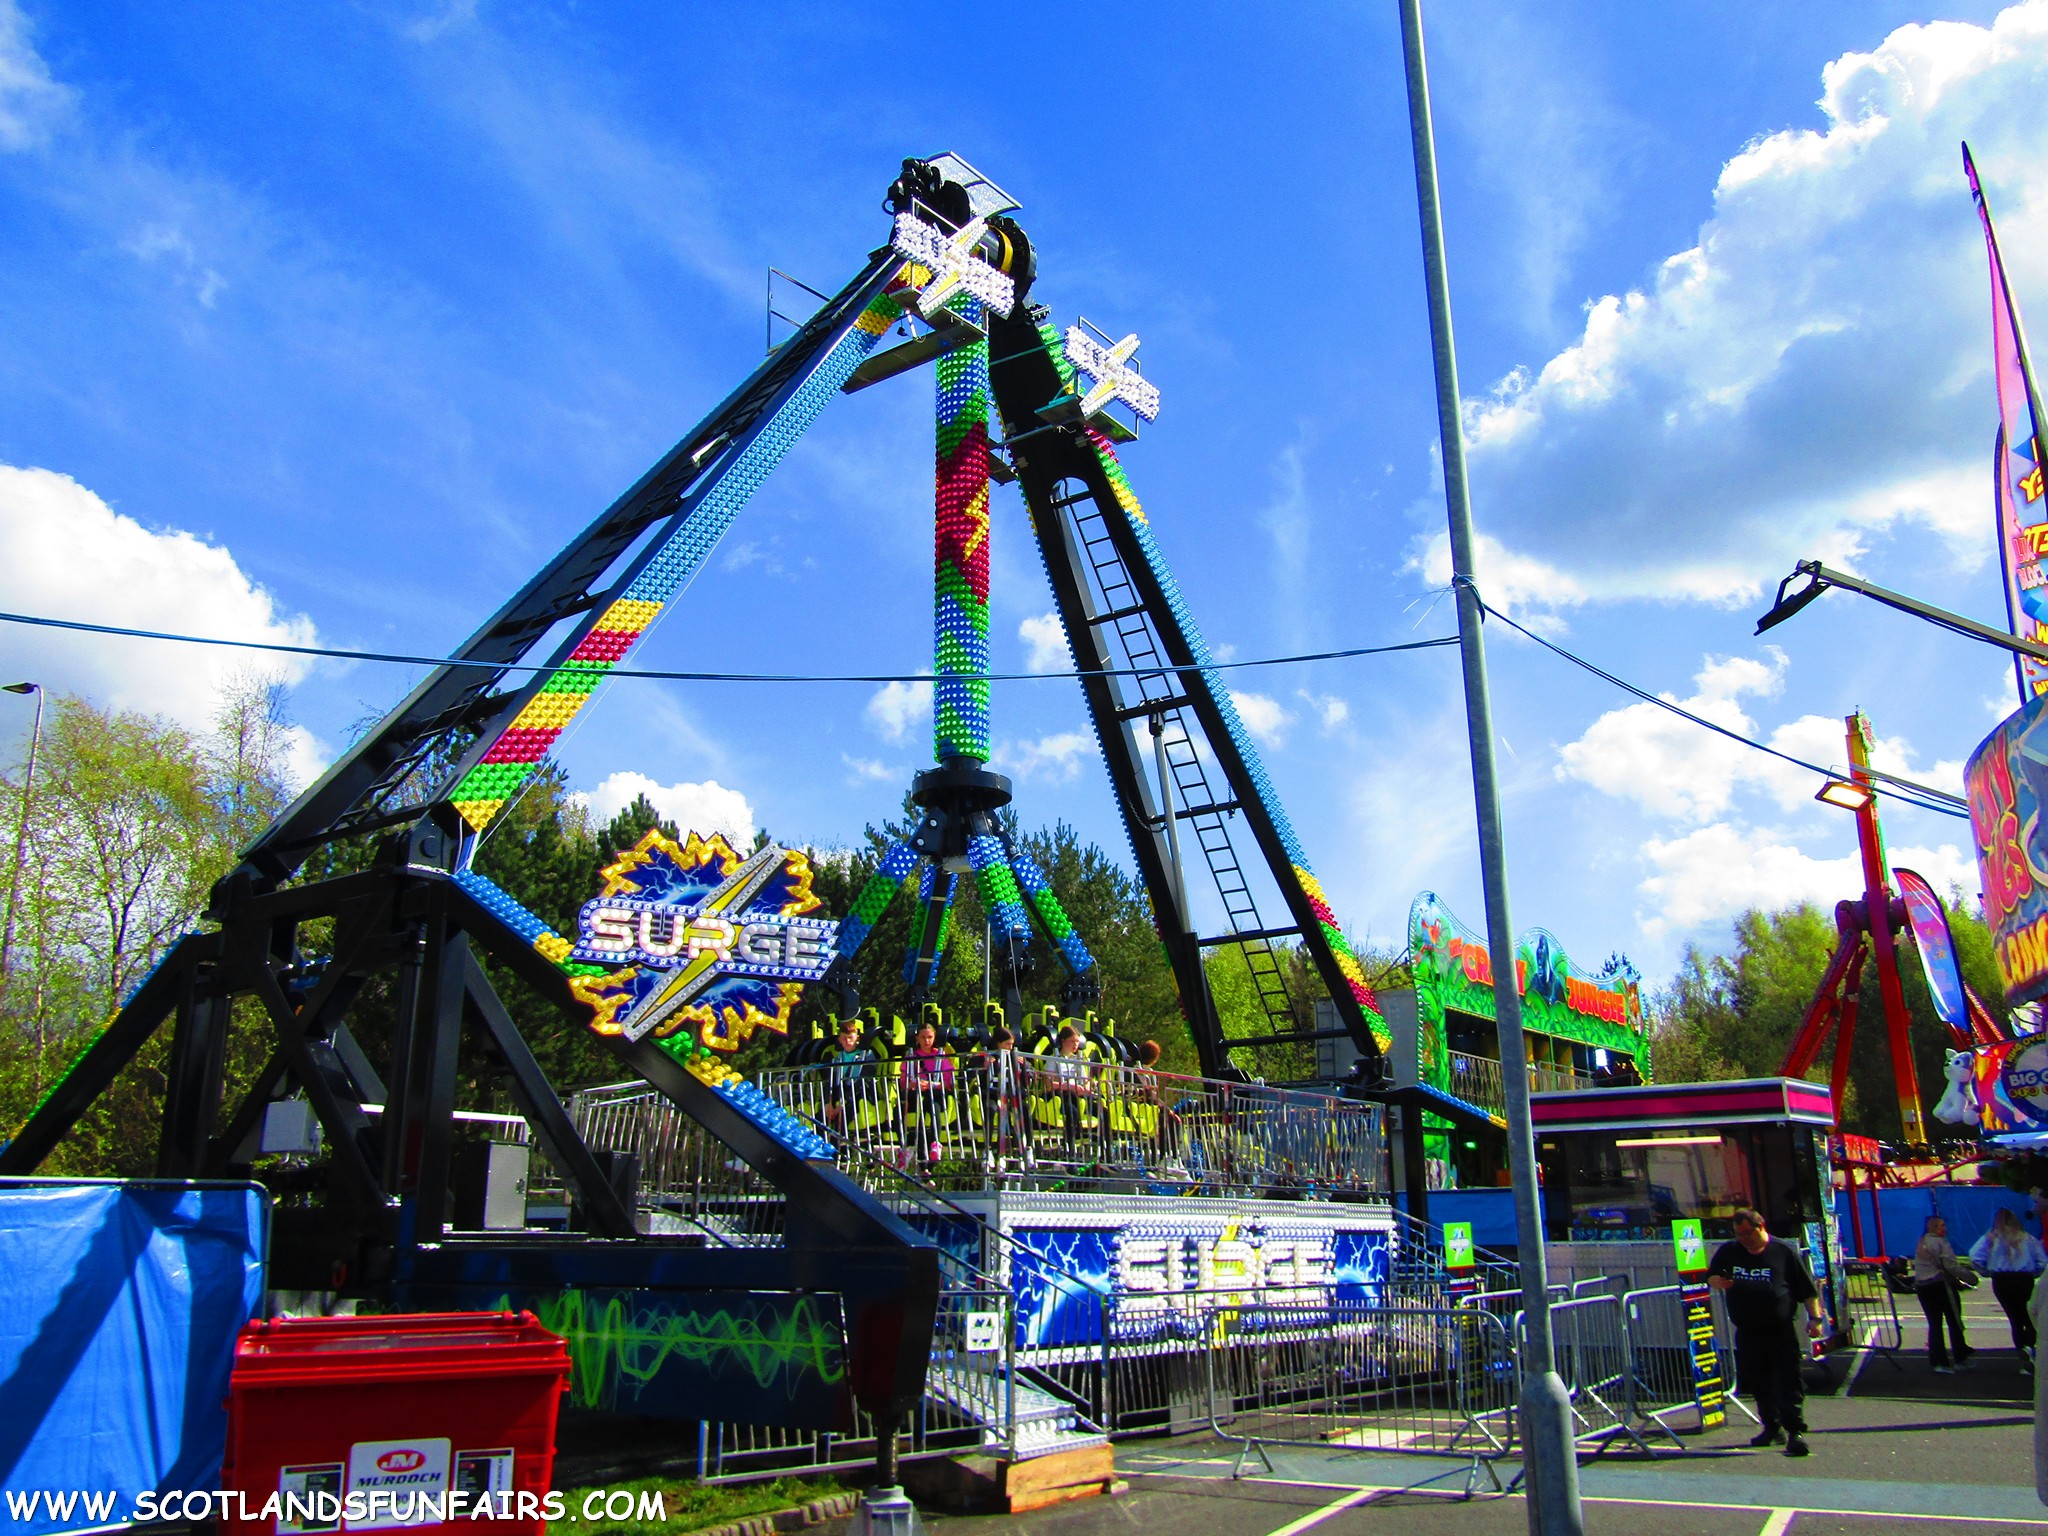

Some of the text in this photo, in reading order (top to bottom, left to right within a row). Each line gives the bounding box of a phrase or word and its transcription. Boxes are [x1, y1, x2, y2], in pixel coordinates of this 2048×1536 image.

[588, 907, 824, 969] SURGE
[1566, 976, 1627, 1026] JUNGLE
[2008, 1071, 2038, 1087] BIG
[380, 1452, 420, 1470] JM
[356, 1472, 442, 1487] MURDOCH
